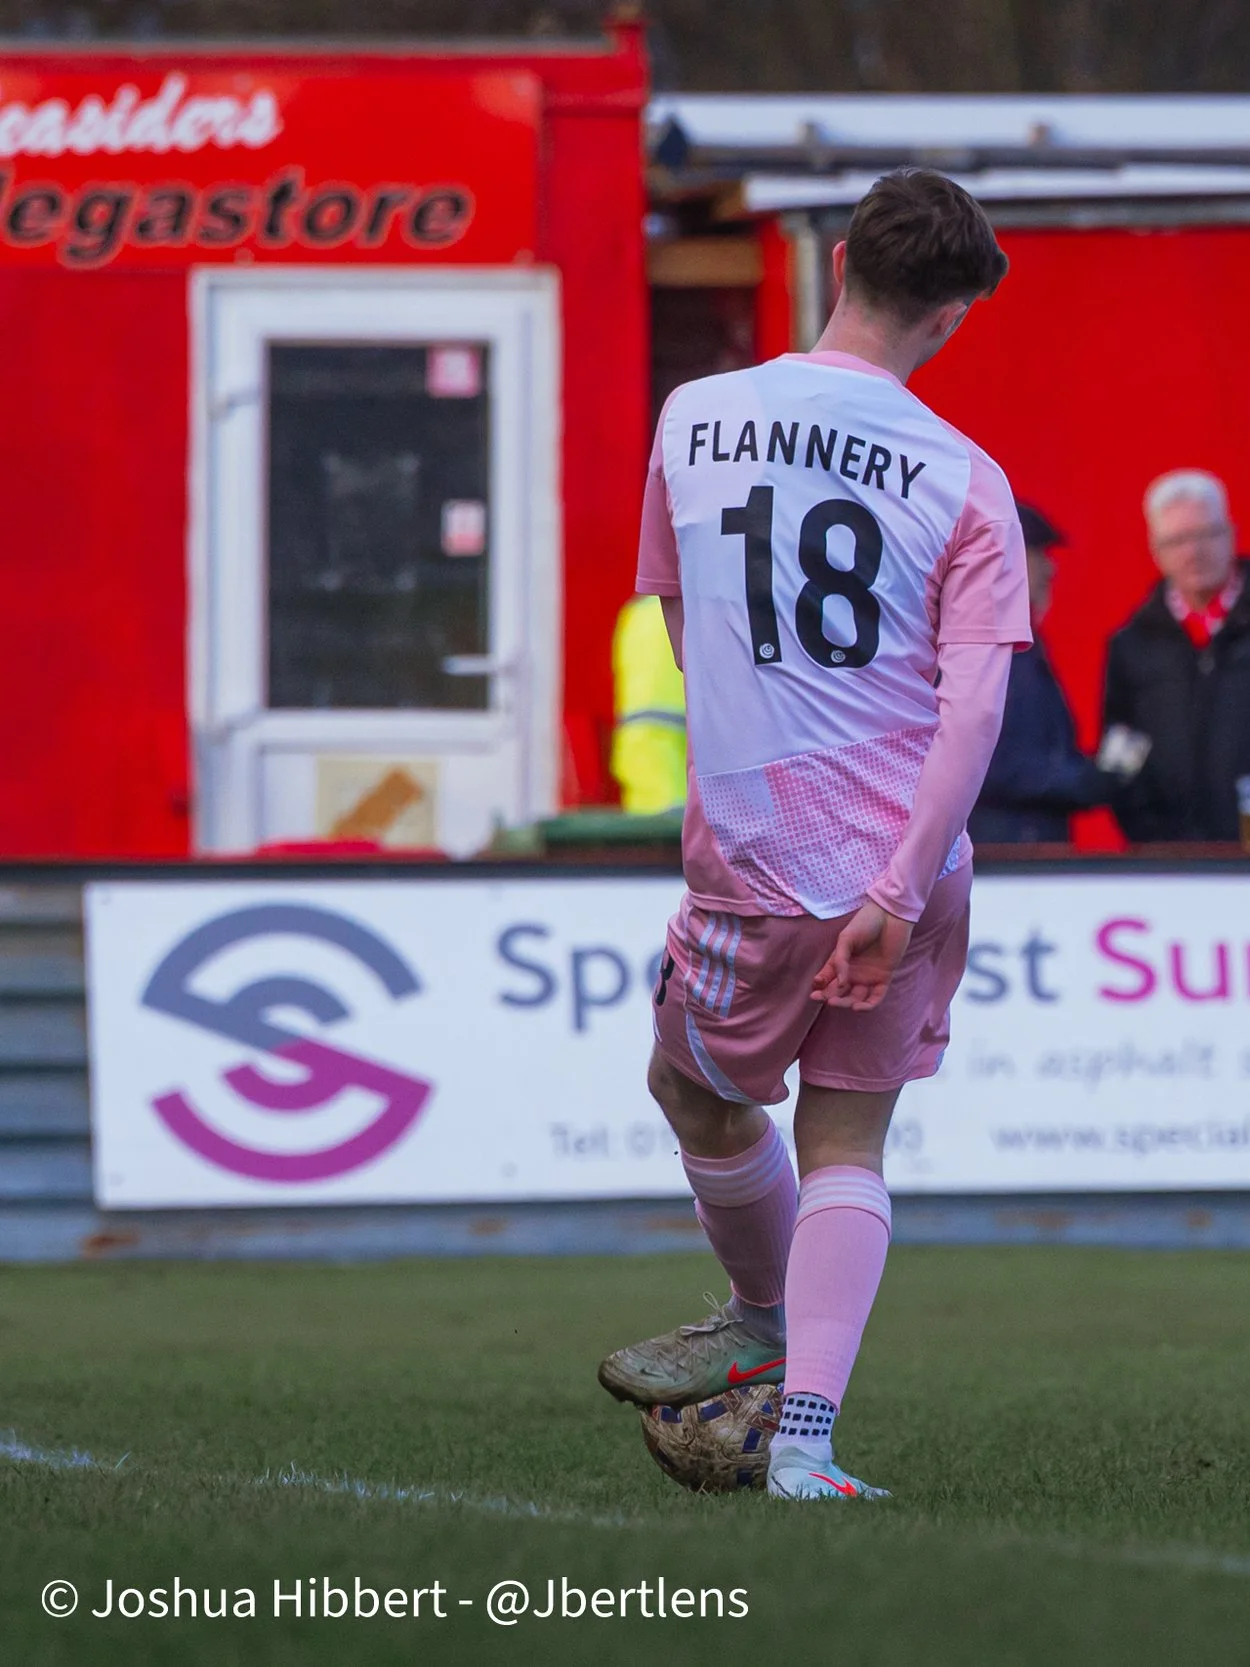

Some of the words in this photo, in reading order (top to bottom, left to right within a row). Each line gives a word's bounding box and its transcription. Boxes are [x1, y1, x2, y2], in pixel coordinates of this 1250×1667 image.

[0, 71, 281, 157] easiders
[0, 168, 474, 267] egastore
[689, 420, 926, 499] FLANNERY
[721, 485, 883, 669] 18
